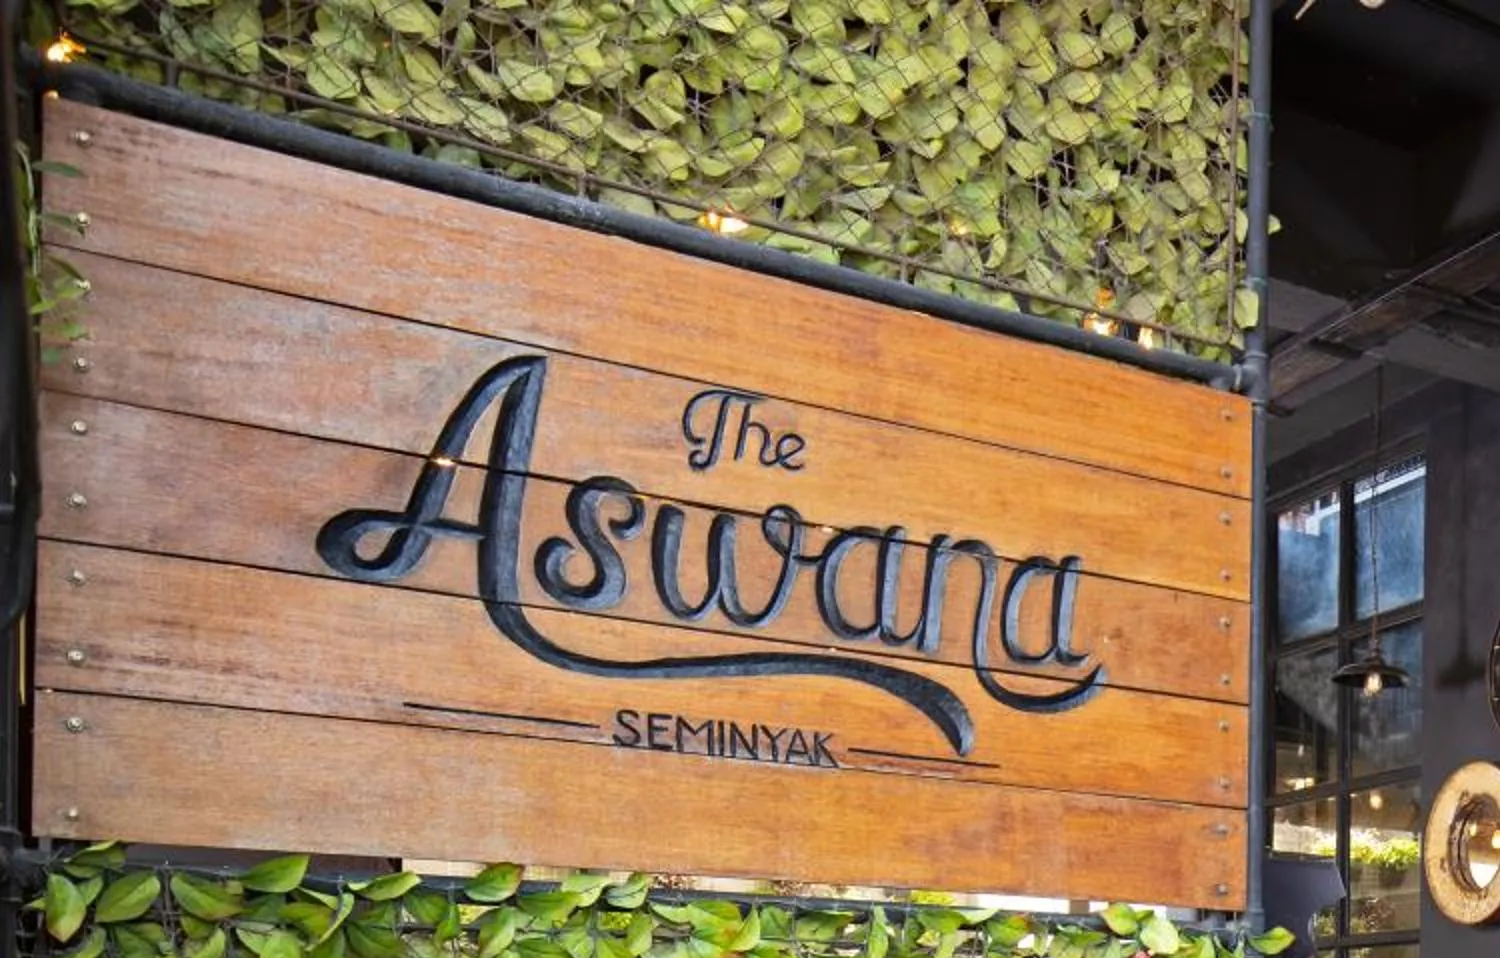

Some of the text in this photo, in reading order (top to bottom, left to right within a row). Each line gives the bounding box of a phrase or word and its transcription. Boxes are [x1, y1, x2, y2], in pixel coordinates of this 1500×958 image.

[682, 388, 807, 474] The
[315, 353, 1108, 757] Aswana
[612, 707, 838, 769] SEMINYAK
